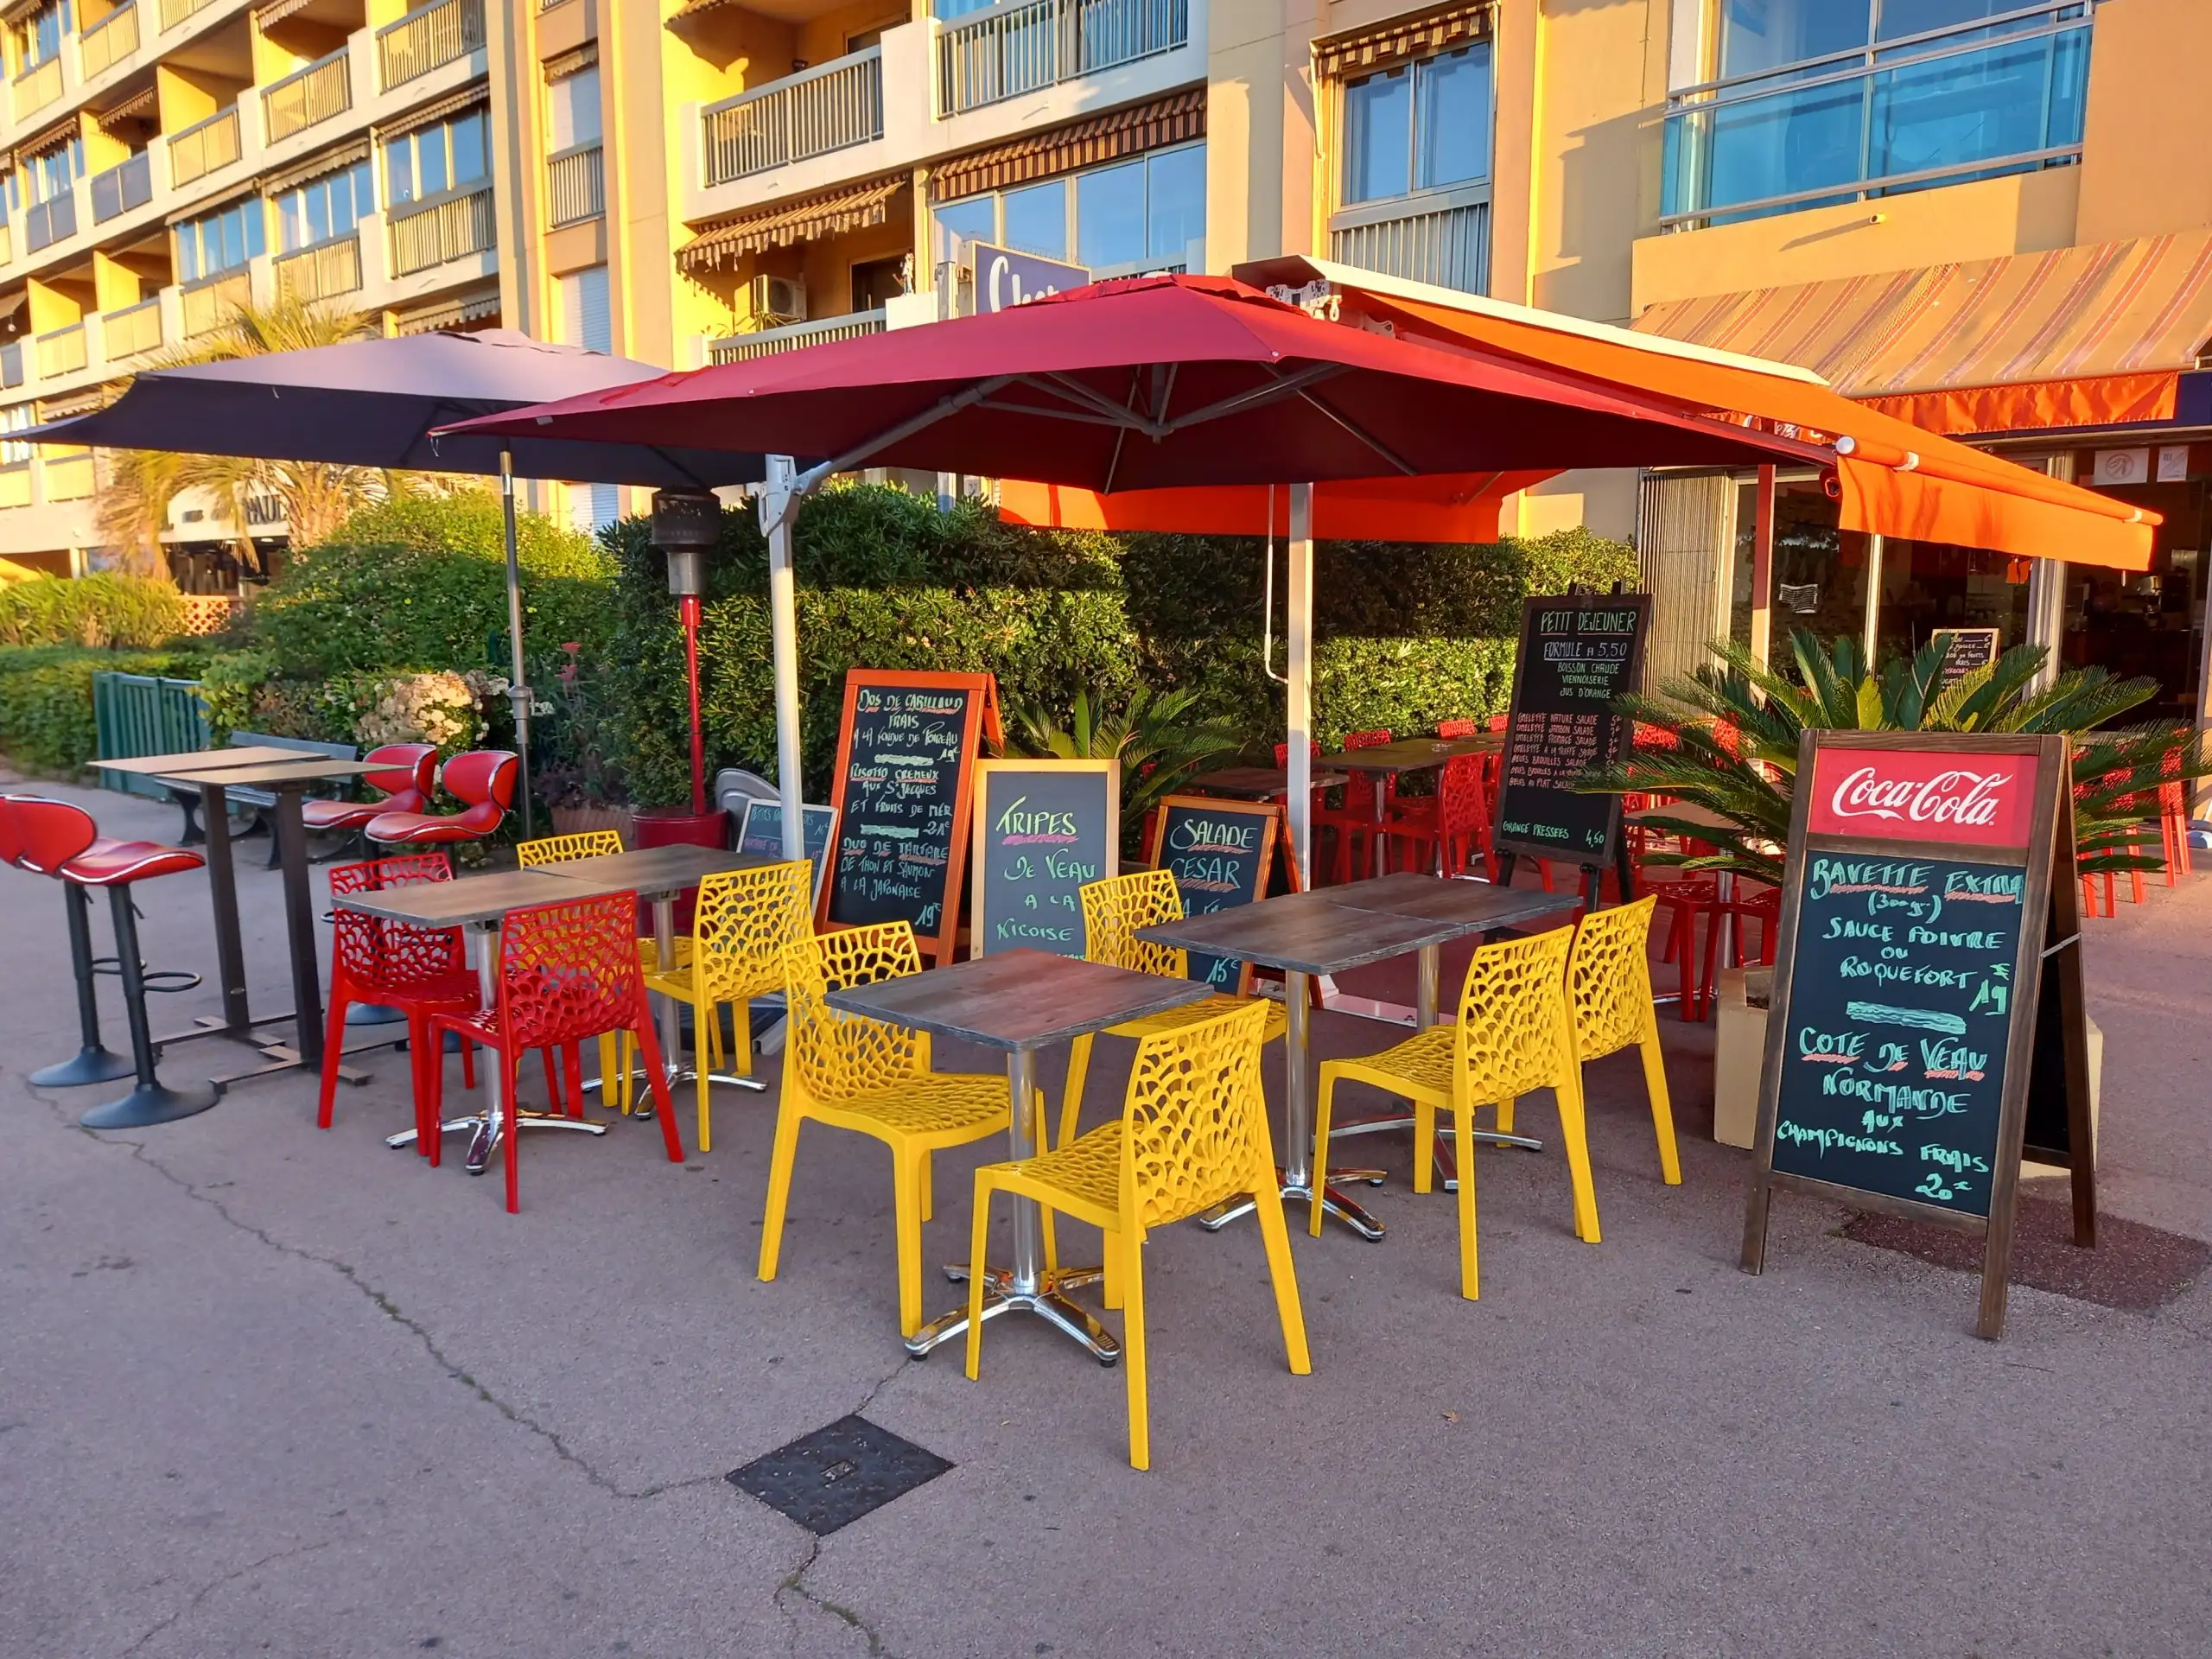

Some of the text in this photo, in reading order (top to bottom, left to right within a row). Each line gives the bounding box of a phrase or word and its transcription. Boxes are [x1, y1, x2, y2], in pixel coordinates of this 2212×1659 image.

[1541, 611, 1637, 632] PETIT DEJEUNER
[1544, 642, 1627, 658] FORMULE A 5,50
[1557, 663, 1620, 674] BOISSON CHAUDE
[1562, 675, 1609, 685] VIENNOISERIE
[883, 695, 901, 711] DE
[905, 694, 963, 712] CABILLAUD
[1560, 688, 1611, 699] JUS D'ORANGE
[888, 709, 919, 729] FRAIS
[1516, 723, 1545, 733] OMELETTE
[1548, 725, 1571, 734] JAMBON
[1573, 726, 1594, 735] SALADE
[1517, 712, 1548, 723] OMELETTE
[1550, 714, 1573, 723] NATURE
[1576, 715, 1599, 725] SALADE
[906, 733, 920, 747] DE
[923, 721, 957, 746] POIREAU
[1575, 737, 1597, 746] SALADE
[850, 763, 939, 780] RISOTTO CREMEUX
[851, 798, 868, 813] ET
[875, 794, 904, 814] FRUITS
[909, 804, 923, 817] DE
[1832, 766, 2013, 826] Coca-Cola
[995, 796, 1077, 835] TRIPES
[1170, 819, 1258, 849] SALADE
[1503, 821, 1605, 848] ORANGE PRESSEES 4,50
[842, 837, 949, 859] DUO DE TARTARE
[840, 855, 935, 882] DE THON ET SAUMON
[1046, 849, 1096, 884] VEAU
[1169, 857, 1241, 888] CESAR
[841, 876, 921, 901] A LA JAPONAISE
[1810, 859, 2024, 905] BAVETTE EXTRA
[1025, 894, 1037, 909] A
[997, 918, 1075, 941] NICOISE
[1822, 917, 2006, 950] SAUCE POIVRE
[1880, 946, 1908, 959] OU
[1840, 956, 1978, 989] ROQUEFORT
[1799, 1027, 1988, 1080] COTE DE VEAU
[1823, 1066, 1971, 1119] NORMANDE
[1862, 1110, 1904, 1134] AUX
[1777, 1120, 1989, 1173] CHAMPIGNONS FRAIS
